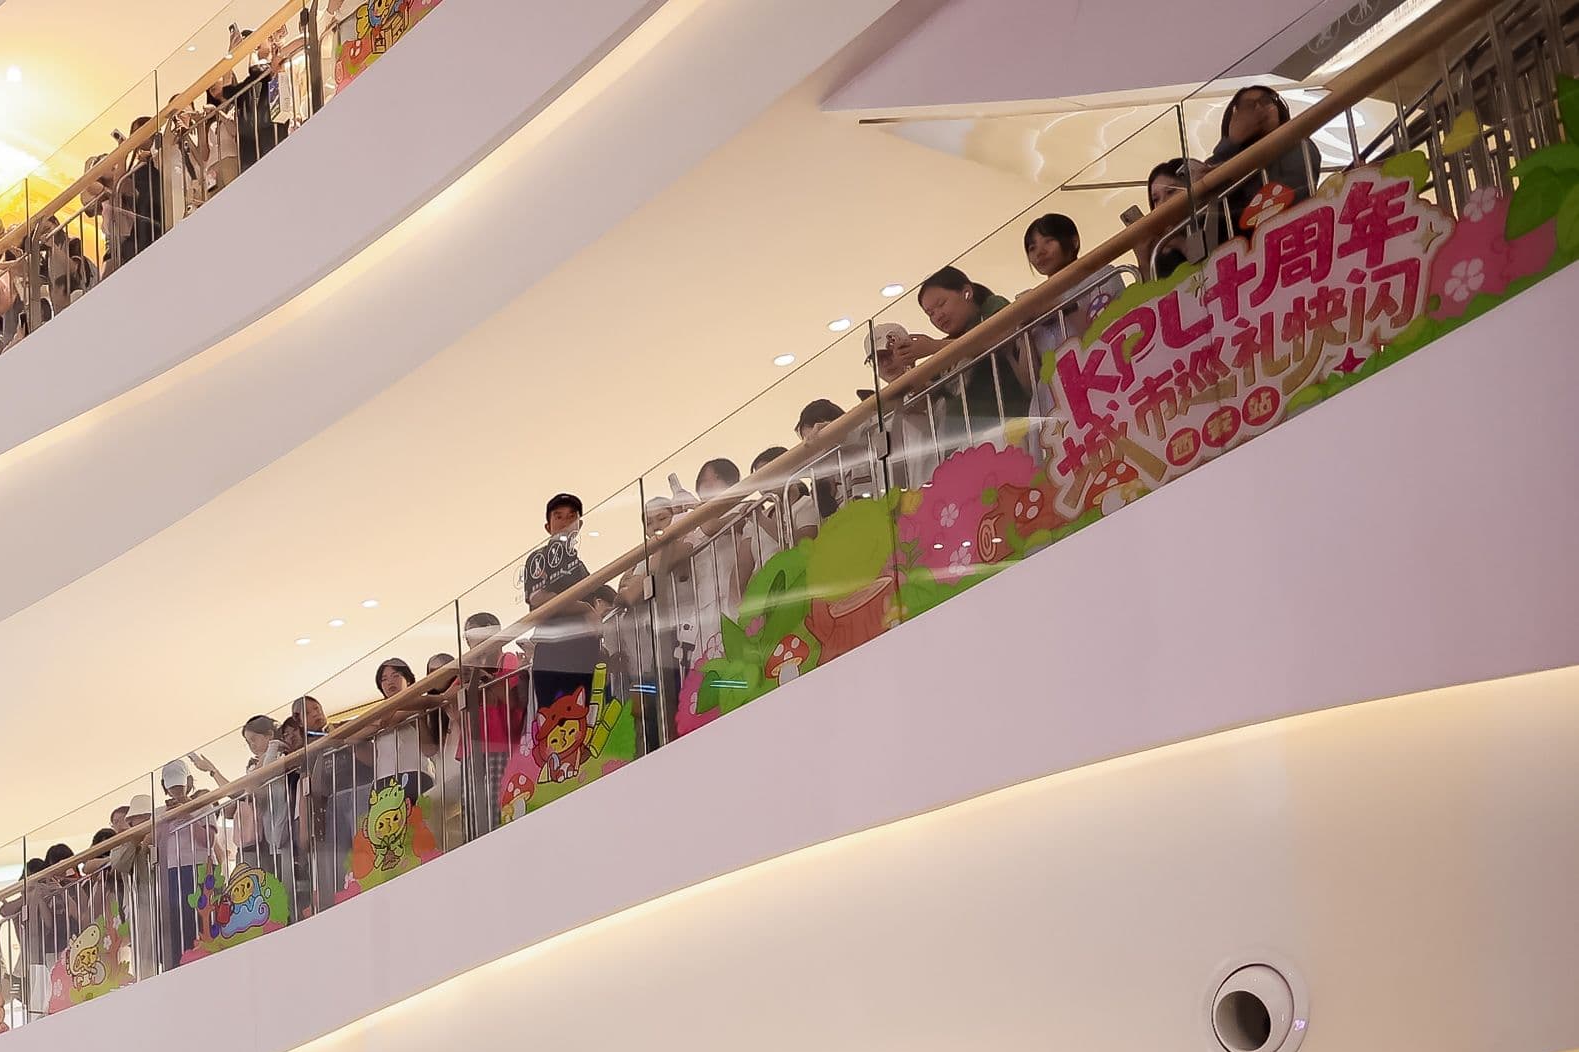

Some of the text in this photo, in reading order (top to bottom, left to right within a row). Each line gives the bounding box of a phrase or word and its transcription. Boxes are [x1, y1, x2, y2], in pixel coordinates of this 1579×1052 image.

[1056, 181, 1420, 429] KPL十周年
[1057, 257, 1422, 508] 城市巡礼快闪
